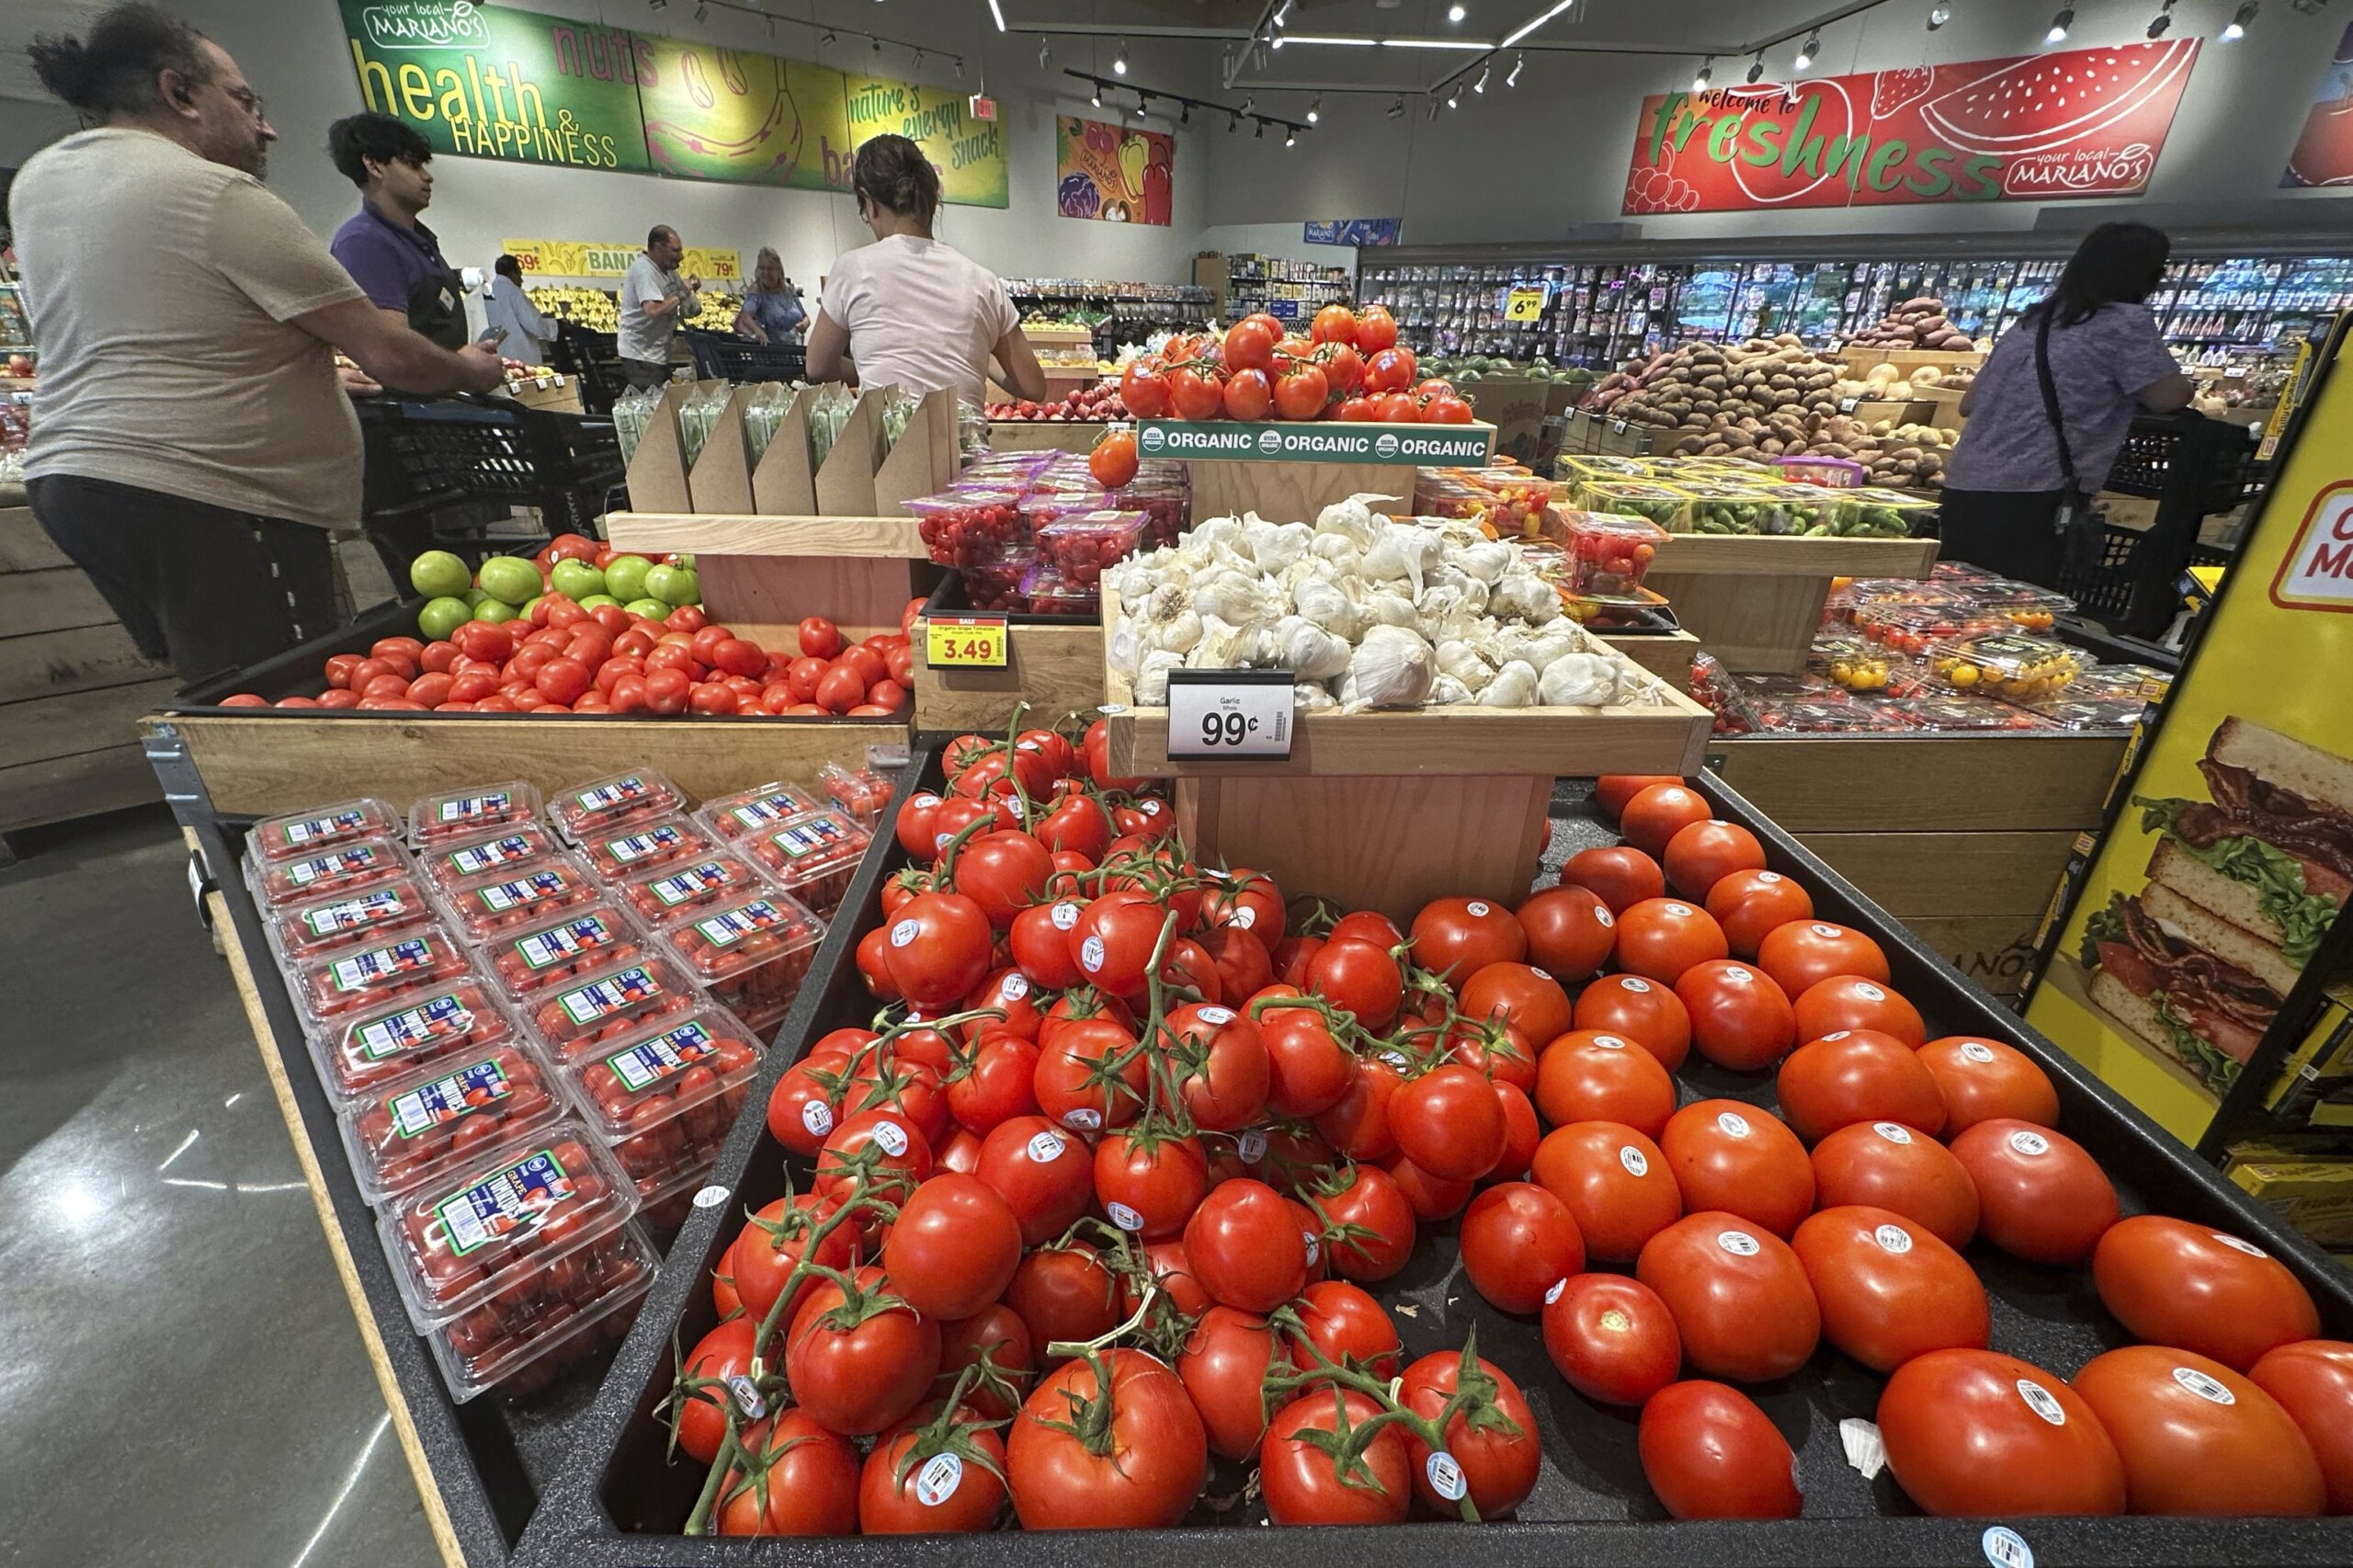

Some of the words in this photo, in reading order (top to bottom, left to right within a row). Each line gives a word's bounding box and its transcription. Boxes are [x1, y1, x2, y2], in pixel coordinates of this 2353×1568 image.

[381, 3, 410, 17] your
[415, 2, 445, 16] local
[372, 16, 483, 43] MARIANO'S
[552, 27, 659, 88] nuts
[351, 39, 547, 134] health
[848, 82, 919, 124] nature's
[1699, 89, 1774, 116] welcome
[1777, 94, 1795, 114] to
[558, 108, 579, 134] &
[903, 99, 963, 142] energy
[449, 116, 619, 168] HAPPINESS
[951, 124, 999, 170] snack
[1650, 92, 2006, 201] freshness
[2036, 153, 2069, 167] your
[2075, 147, 2111, 163] local
[2012, 159, 2146, 189] MARIANO'S
[587, 251, 644, 270] BANA
[1167, 432, 1252, 449] ORGANIC
[1284, 435, 1370, 452] ORGANIC
[1401, 439, 1485, 457] ORGANIC
[944, 639, 992, 659] 3.49
[1220, 697, 1241, 705] Garlic
[1201, 711, 1259, 746] 99¢
[506, 1169, 528, 1196] GRAPE
